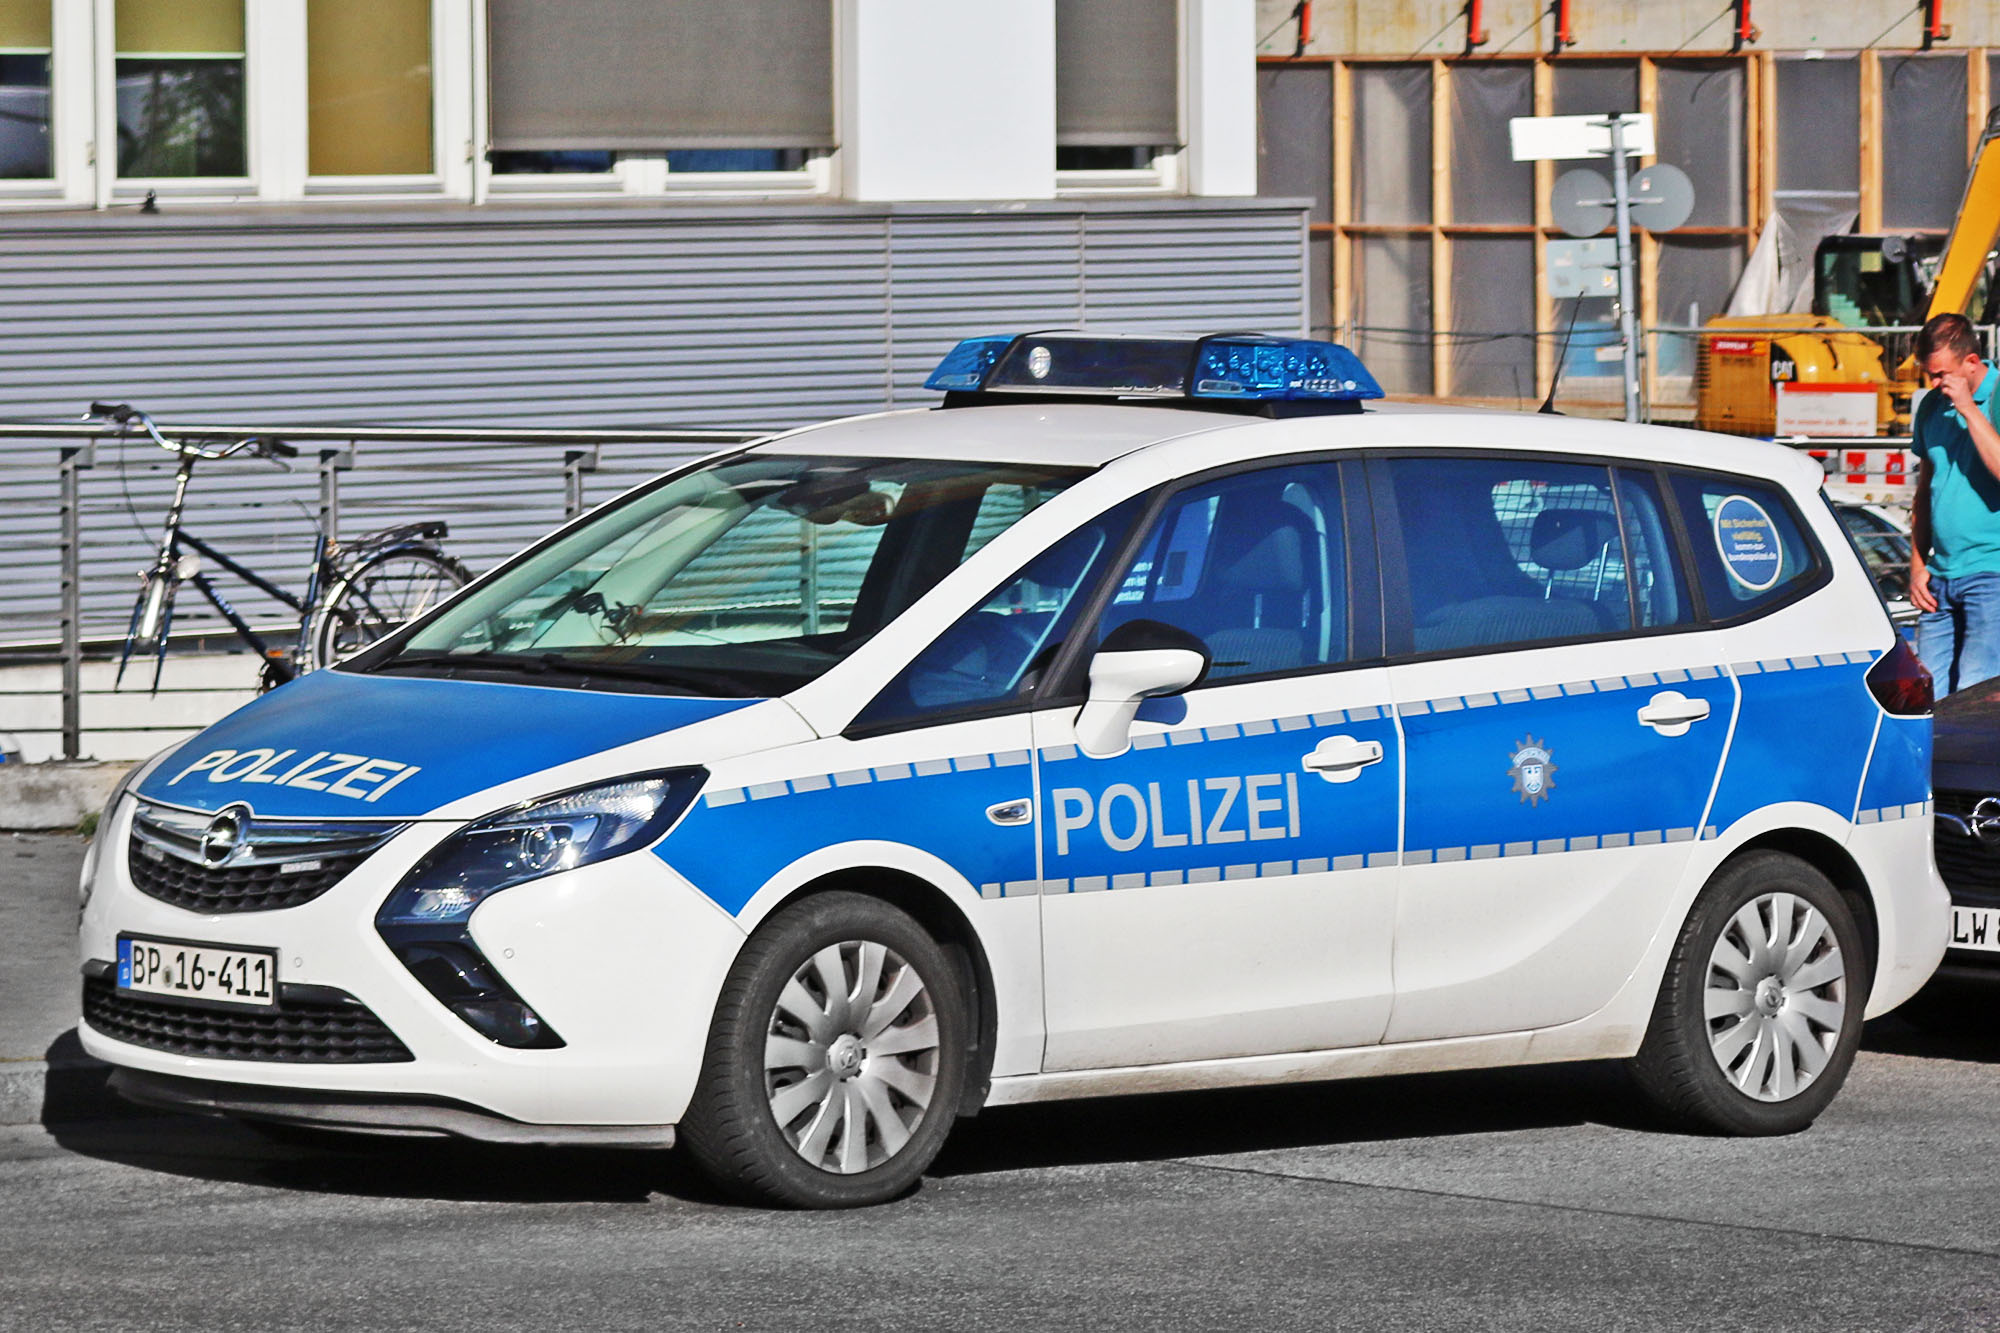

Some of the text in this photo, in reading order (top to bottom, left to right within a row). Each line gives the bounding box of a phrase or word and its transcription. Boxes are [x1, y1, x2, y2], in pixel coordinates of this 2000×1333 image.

[1771, 360, 1795, 380] CAT
[167, 748, 422, 802] POLIZEI
[1052, 772, 1300, 856] POLIZEI
[1953, 911, 1988, 944] LW
[133, 945, 270, 998] BP 16-411
